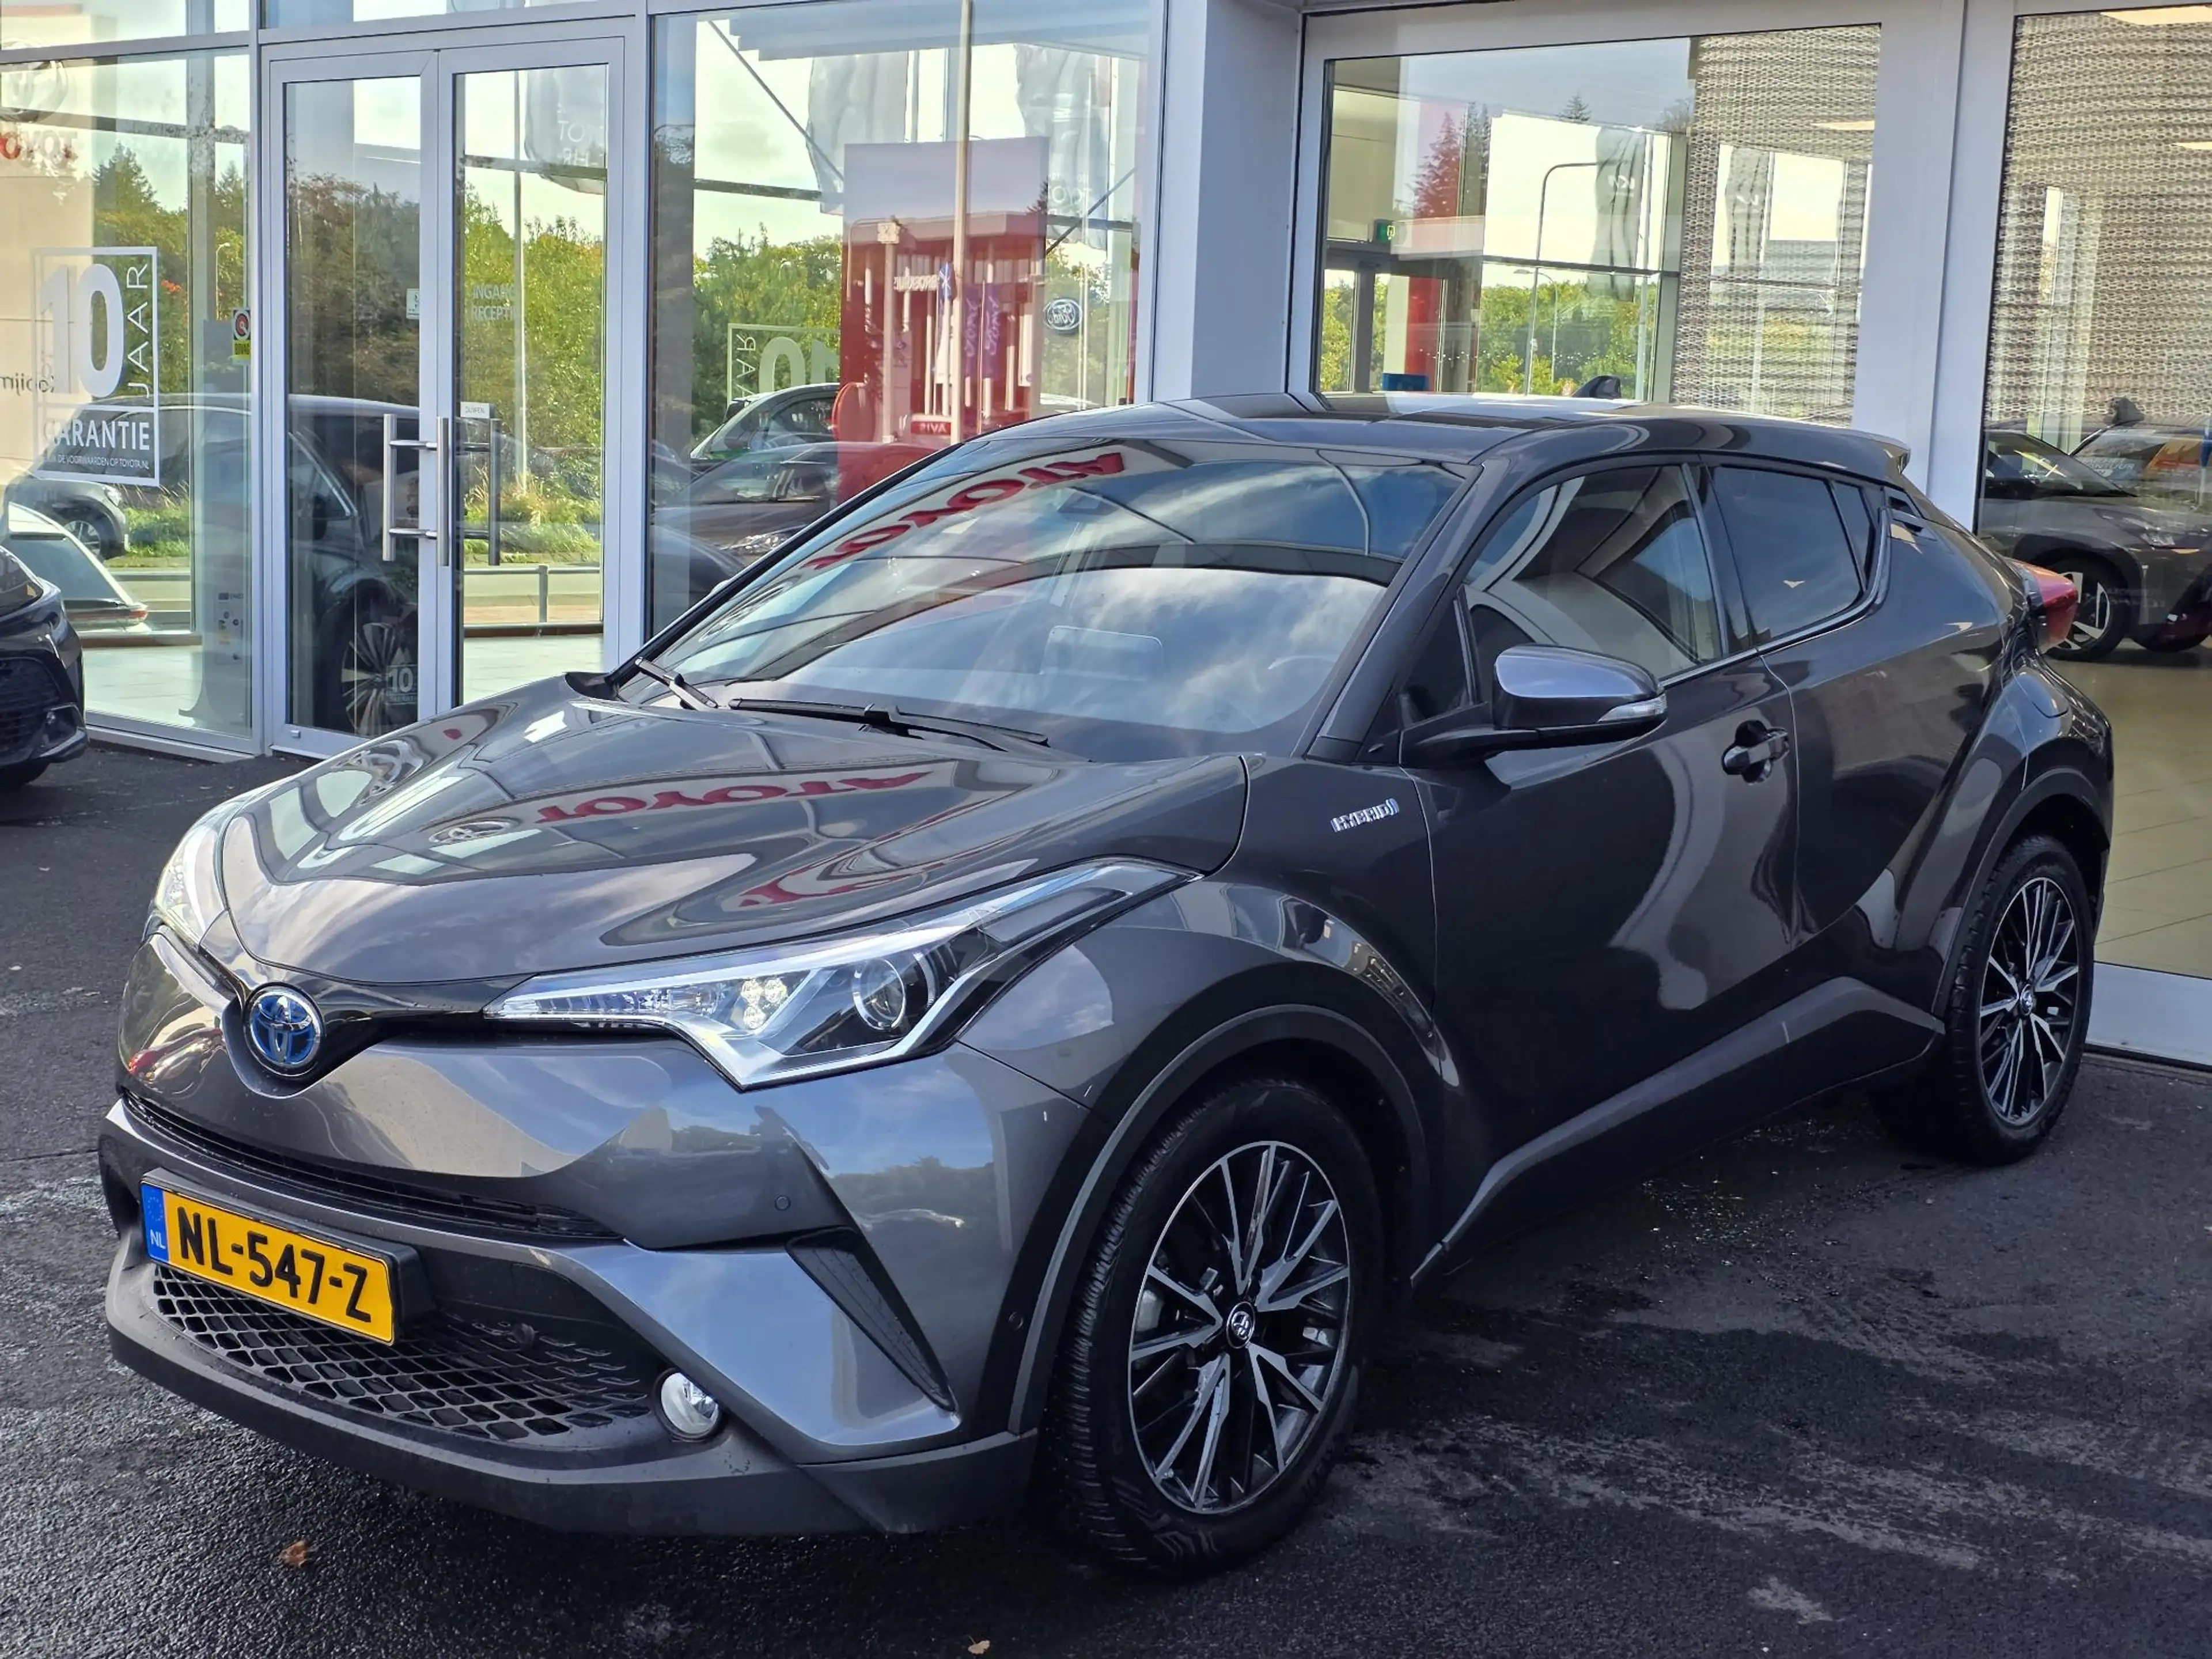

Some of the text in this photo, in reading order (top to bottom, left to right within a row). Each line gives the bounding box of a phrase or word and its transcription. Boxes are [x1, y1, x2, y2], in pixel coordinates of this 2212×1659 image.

[41, 263, 124, 399] 10
[126, 263, 149, 400] JAAR
[44, 419, 150, 450] GARANTIE
[388, 667, 414, 692] 10
[1330, 800, 1396, 833] HYBRID
[149, 1228, 166, 1250] NL
[177, 1206, 372, 1323] NL-547-Z
